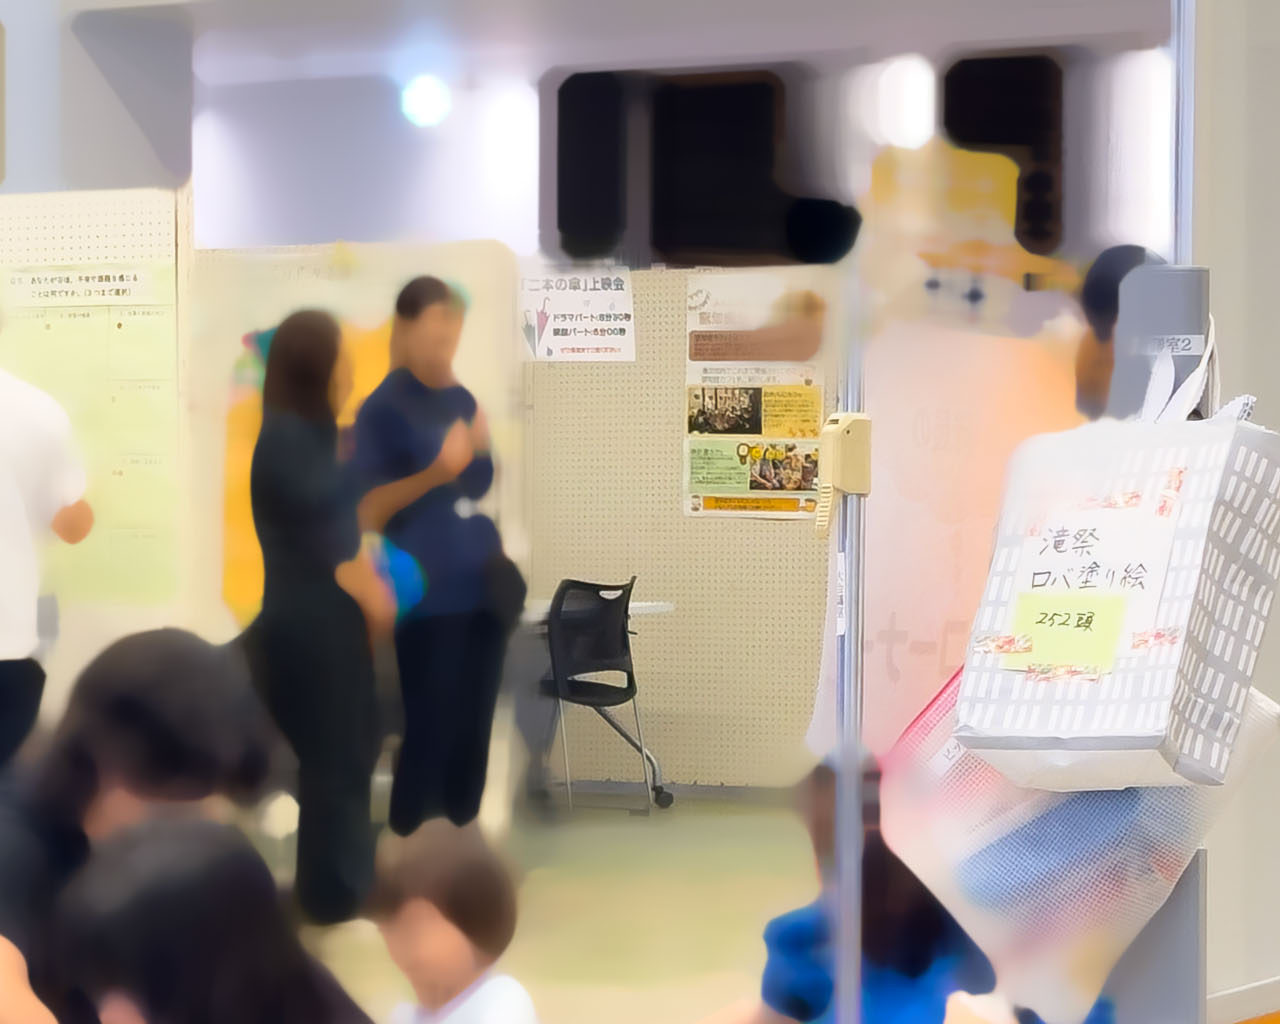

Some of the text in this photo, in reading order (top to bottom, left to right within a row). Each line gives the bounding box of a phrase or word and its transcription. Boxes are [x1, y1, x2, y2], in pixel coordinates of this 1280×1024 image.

[1039, 526, 1101, 558] 滝祭
[1031, 560, 1148, 590] ロバ塗り絵
[1035, 611, 1095, 632] 252頭
